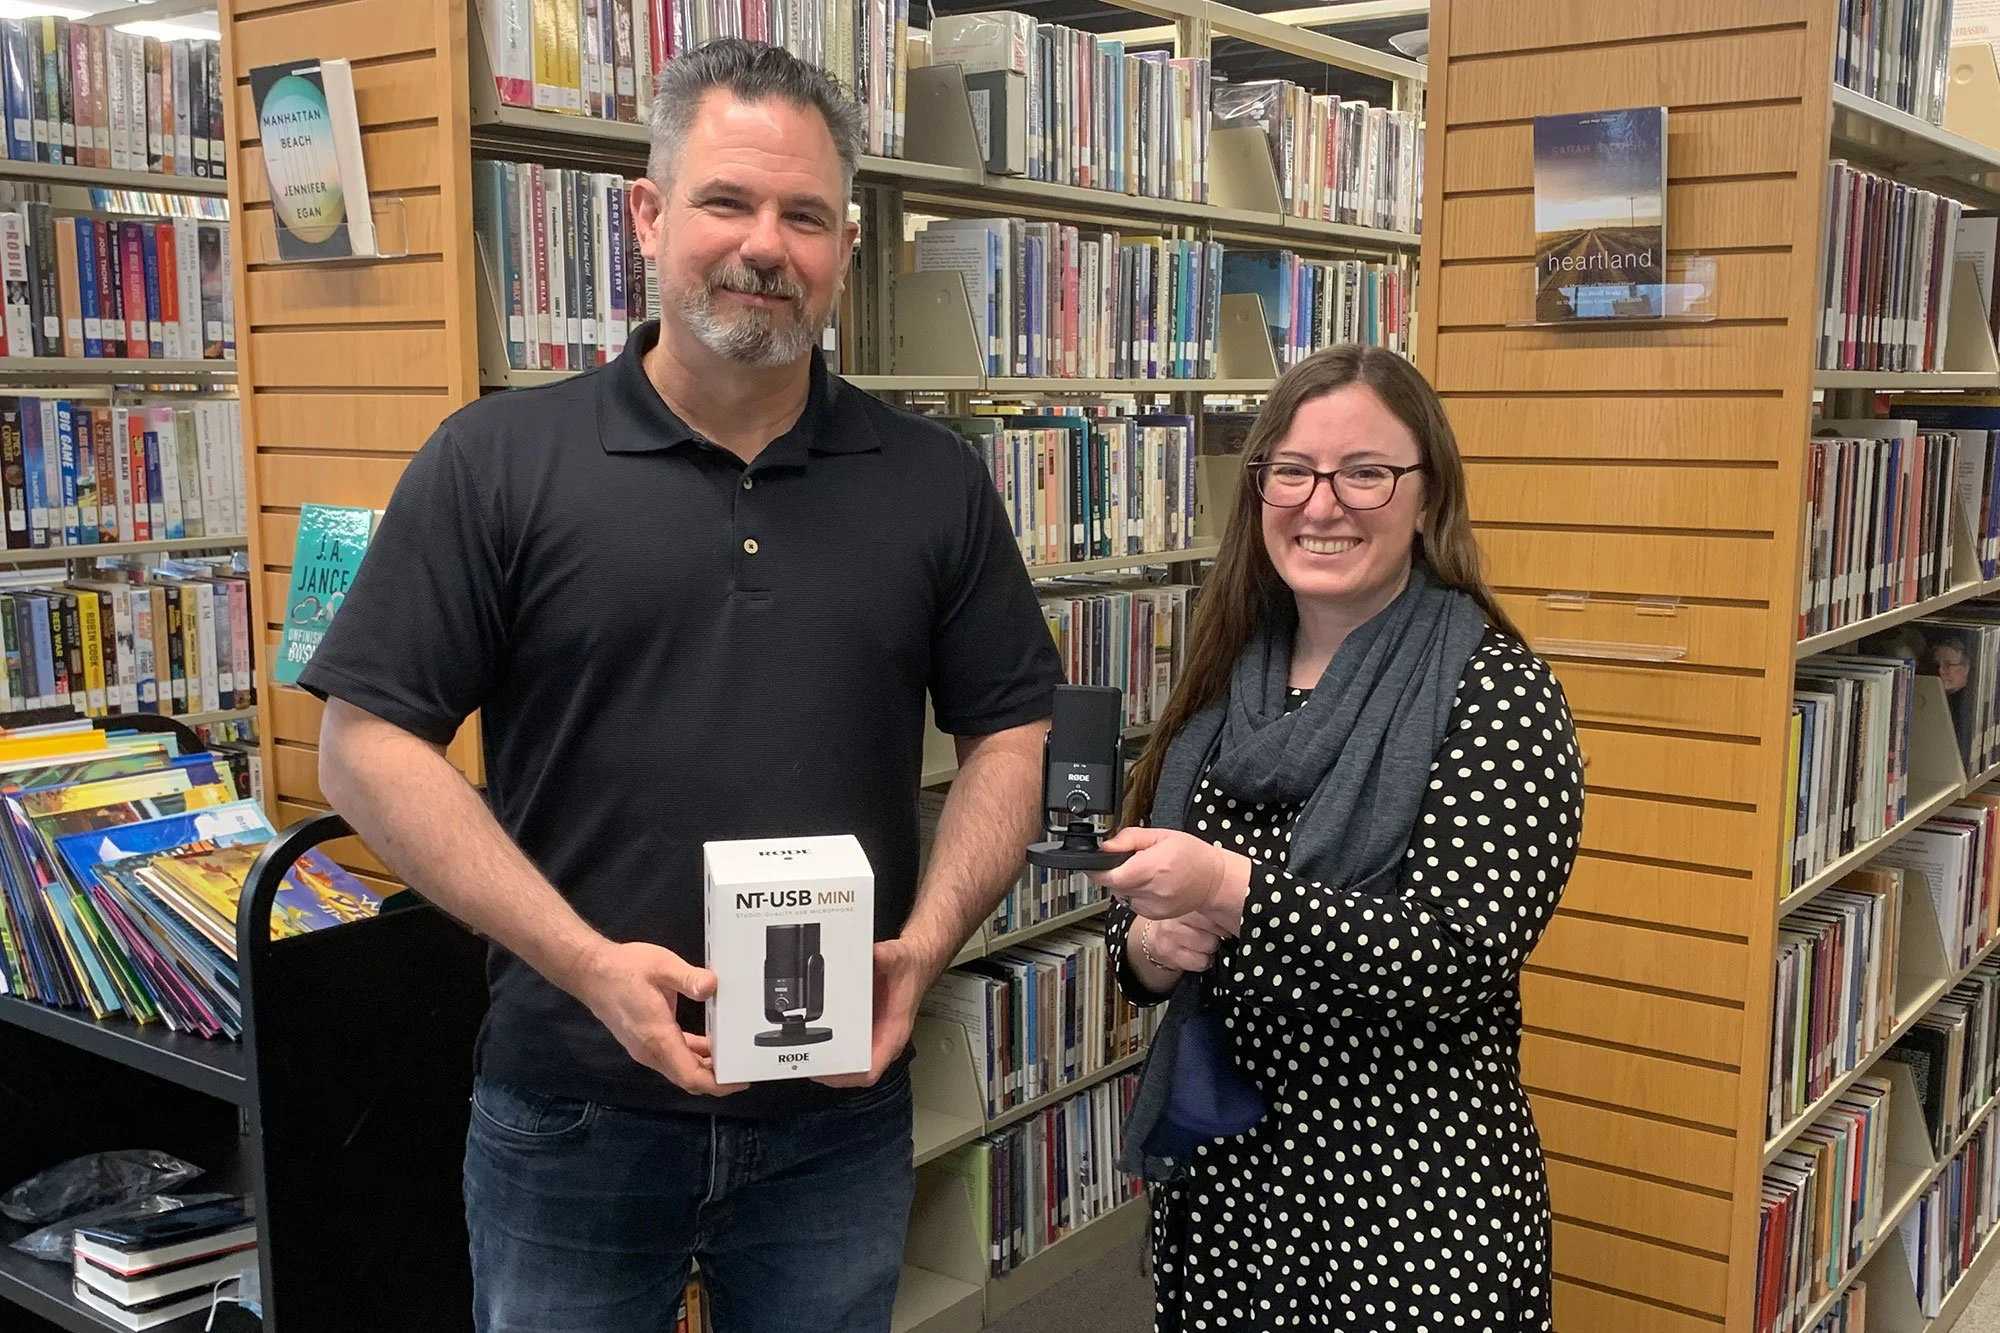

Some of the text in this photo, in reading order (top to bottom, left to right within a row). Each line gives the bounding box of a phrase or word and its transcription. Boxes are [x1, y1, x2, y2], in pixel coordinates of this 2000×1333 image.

[791, 0, 799, 46] AMLET
[642, 12, 651, 76] Casterbrid
[263, 109, 321, 127] MANHATTAN
[280, 135, 312, 149] BEACH
[1552, 144, 1591, 157] SARAH
[284, 182, 328, 197] JENNIFER
[297, 206, 322, 219] EGAN
[535, 190, 543, 219] STORY
[582, 208, 590, 226] Diary
[611, 189, 620, 227] LARRY
[537, 222, 543, 232] OF
[551, 206, 559, 248] Frankenstein
[566, 184, 576, 260] Auntie Mame
[6, 231, 23, 278] ROBIN
[538, 237, 544, 248] MY
[583, 241, 591, 261] Young
[98, 236, 109, 295] JODI THOMAS
[584, 262, 592, 277] Girl
[632, 236, 642, 280] MICHAELS
[1018, 247, 1026, 293] Daughter
[1548, 248, 1652, 272] heartland
[512, 280, 521, 300] MAX
[584, 284, 593, 309] ANNE
[647, 277, 661, 320] MORRIS
[1019, 296, 1026, 306] of
[202, 409, 210, 441] American
[59, 410, 74, 470] BIG GAME
[96, 424, 107, 481] OF THE GIRLS
[105, 445, 113, 479] SILENCE
[120, 456, 129, 481] BLACK
[204, 442, 212, 470] Dialogue
[64, 475, 74, 496] MARK
[316, 534, 343, 563] J. A.
[297, 565, 350, 594] JANCE
[51, 611, 63, 658] RED WAR
[86, 612, 99, 668] ROBIN COOK
[288, 628, 325, 643] UNFINISH
[287, 642, 318, 664] BUSI
[736, 890, 855, 910] NT-USB MINI
[778, 1052, 810, 1063] RØDE
